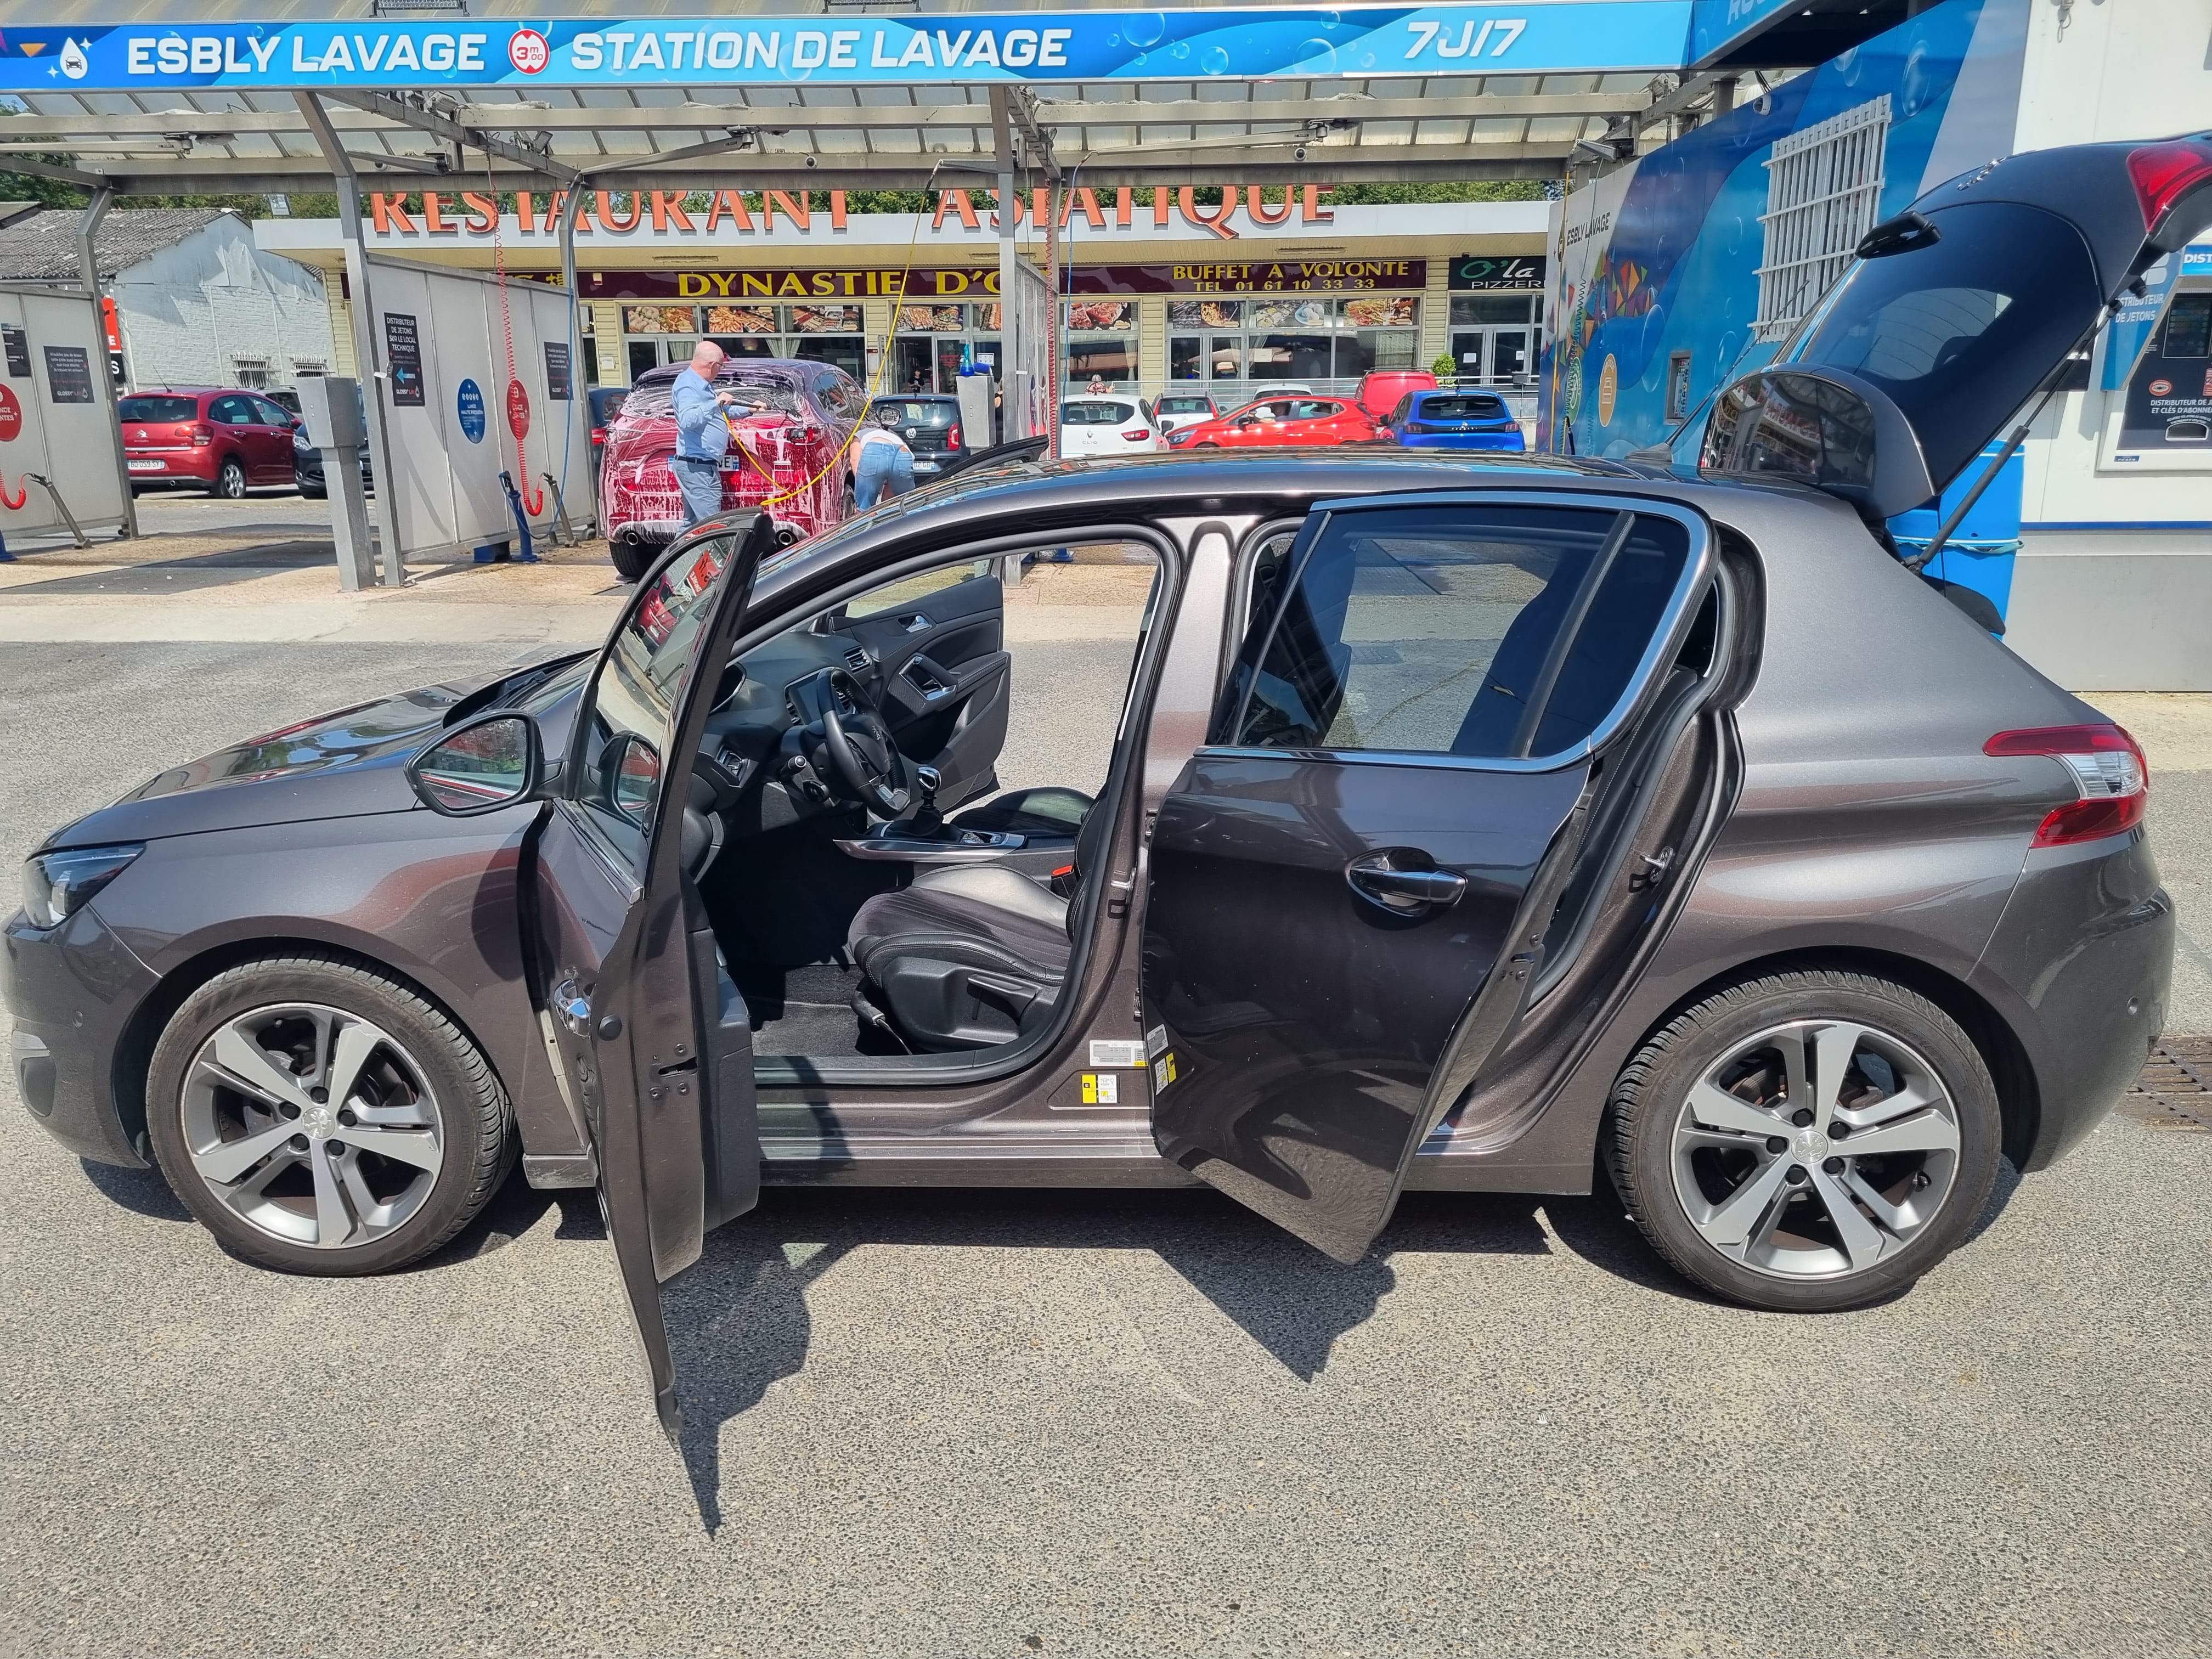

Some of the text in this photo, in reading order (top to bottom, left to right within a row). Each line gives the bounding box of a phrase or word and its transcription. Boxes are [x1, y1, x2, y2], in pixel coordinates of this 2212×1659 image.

[572, 29, 1073, 70] STATION DE LAVAGE
[1403, 19, 1527, 59] 7J/7
[128, 34, 487, 74] ESBLY LAVAGE
[1567, 212, 1610, 246] ESBLY LAVAGE
[1173, 261, 1409, 280] BUFFET A VOLONTE
[678, 271, 901, 297] DYNASTIE
[1194, 279, 1375, 292] TEL 01 61 10 33 33
[386, 317, 415, 326] DISTRIBUTEUR
[2115, 311, 2156, 323] DE JETONS
[392, 344, 415, 353] TECHNIQUE
